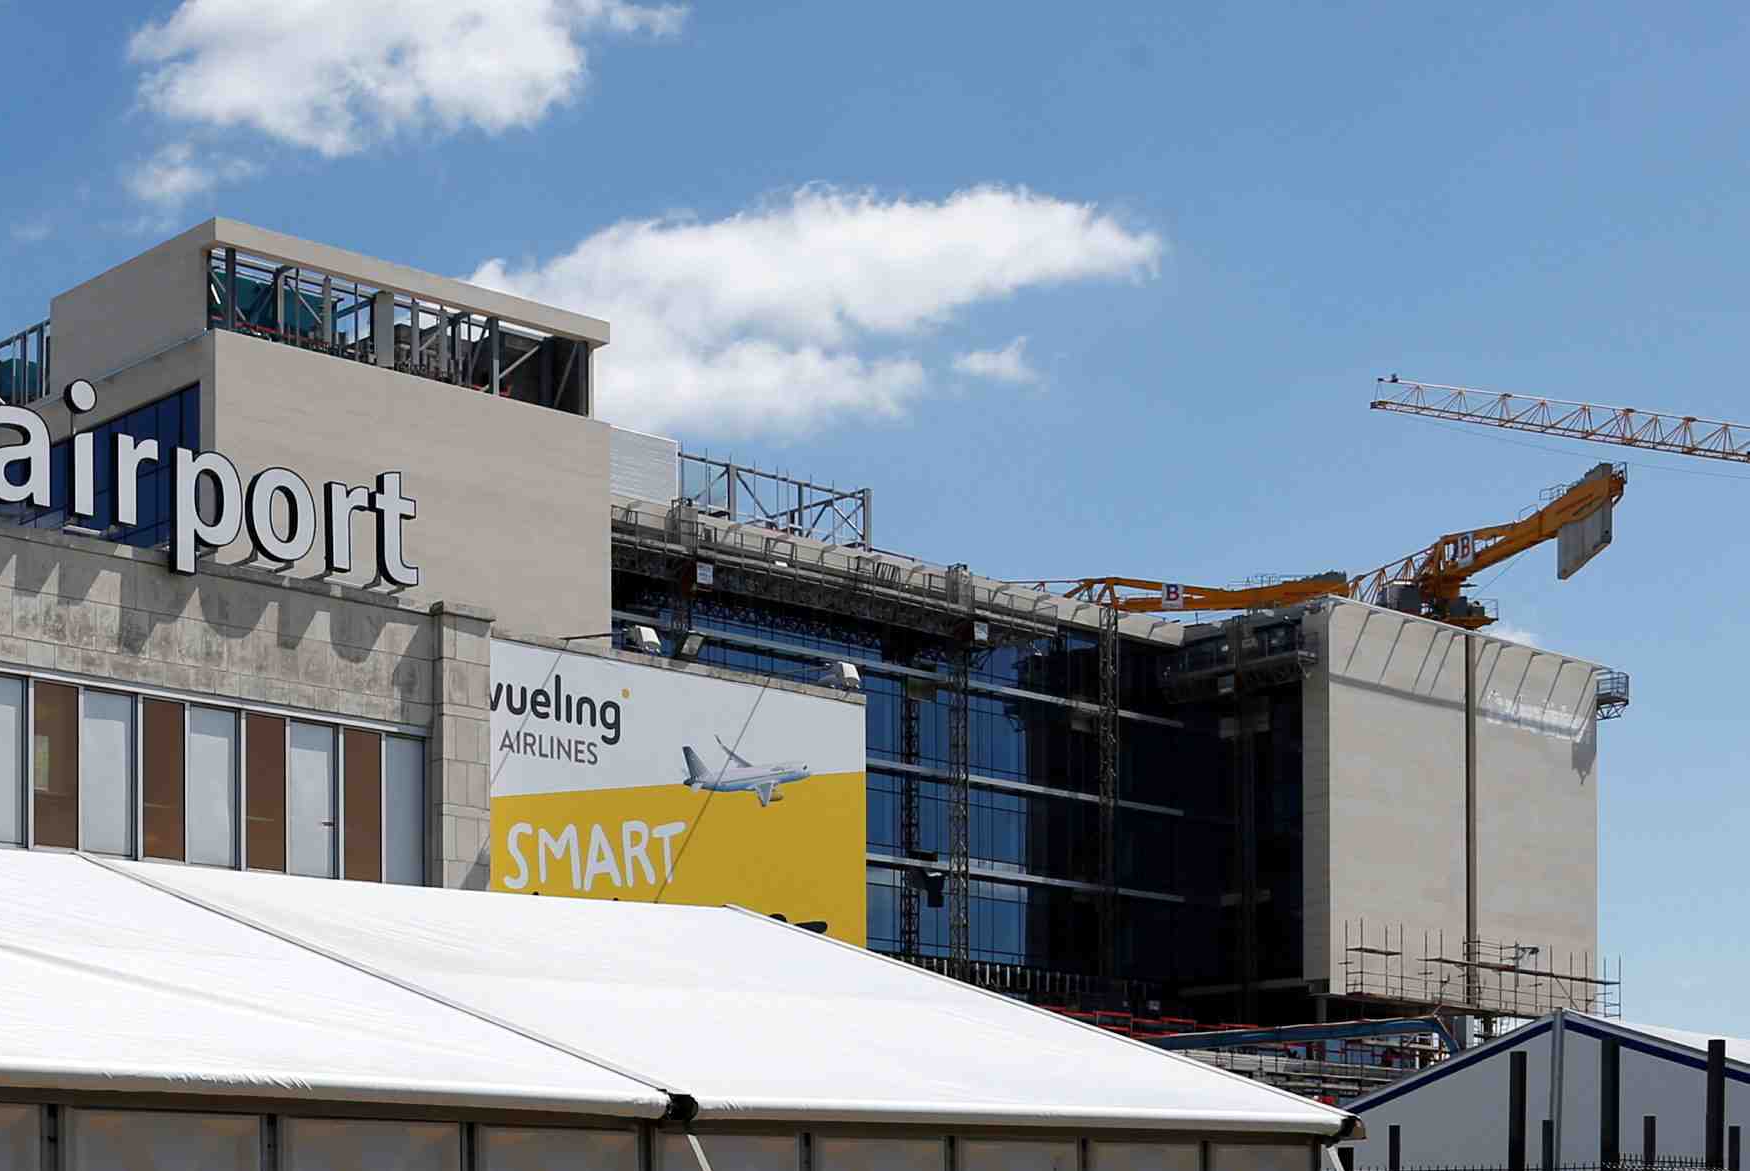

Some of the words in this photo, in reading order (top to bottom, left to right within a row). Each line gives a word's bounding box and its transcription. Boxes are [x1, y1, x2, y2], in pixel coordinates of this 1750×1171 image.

[1165, 583, 1180, 601] B
[490, 674, 621, 745] vueling
[499, 730, 598, 765] AIRLINES
[503, 819, 687, 892] SMART
